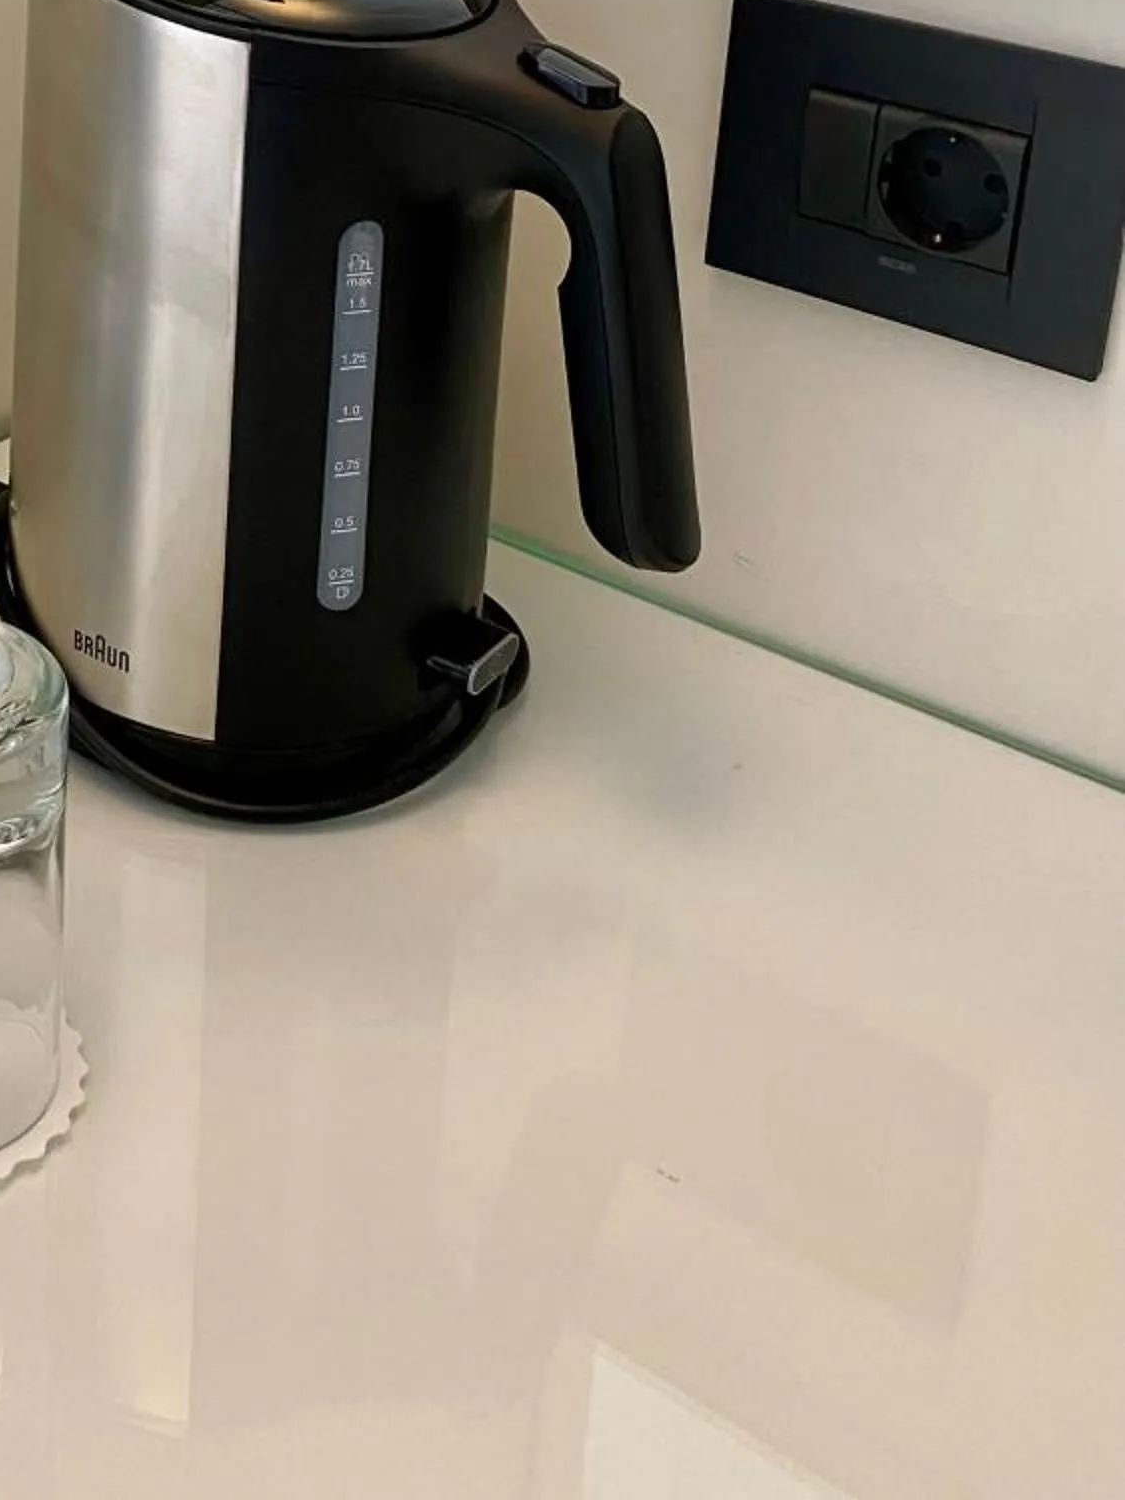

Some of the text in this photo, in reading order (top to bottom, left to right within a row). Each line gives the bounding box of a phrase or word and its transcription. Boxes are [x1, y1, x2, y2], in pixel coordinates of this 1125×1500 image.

[347, 278, 372, 287] max
[342, 404, 361, 417] 1.0
[334, 458, 361, 473] 0.75
[334, 516, 354, 528] 0.5
[328, 568, 354, 581] 0.25
[74, 629, 130, 673] BRAUN
